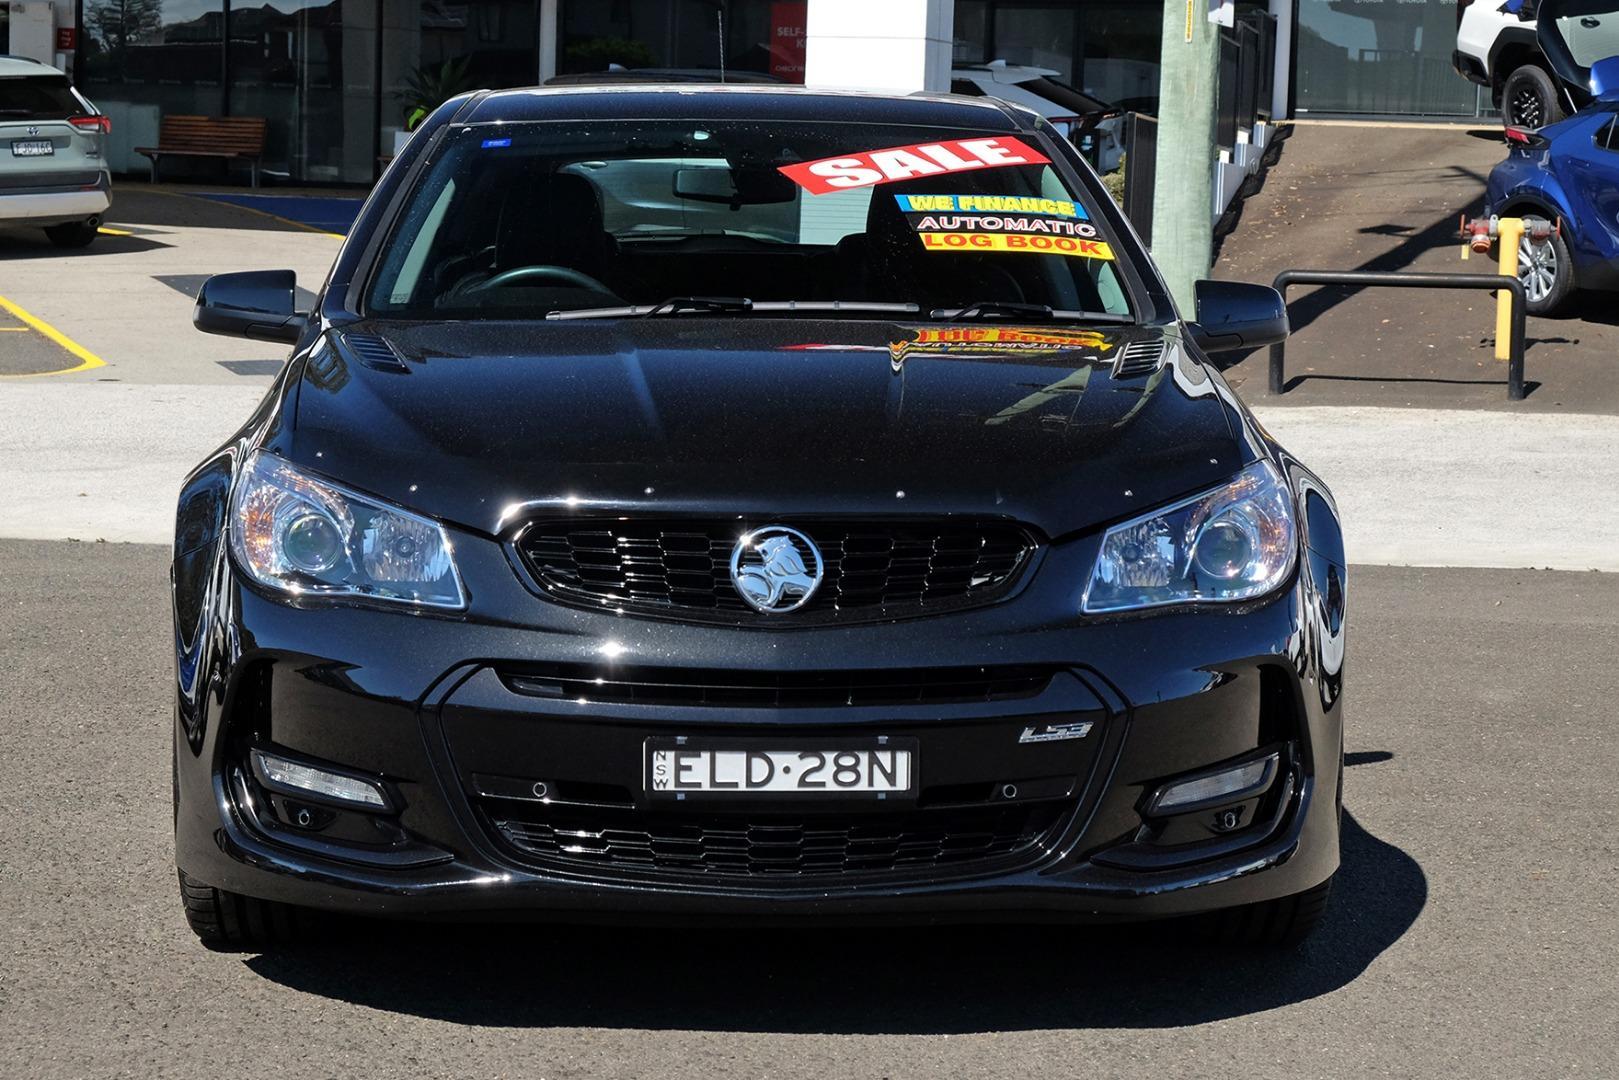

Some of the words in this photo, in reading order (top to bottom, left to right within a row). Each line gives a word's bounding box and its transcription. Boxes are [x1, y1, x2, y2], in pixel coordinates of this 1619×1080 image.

[808, 139, 1027, 188] SALE
[907, 195, 954, 211] WE
[959, 196, 1077, 216] FINANCE
[917, 216, 1097, 237] AUTOMATIC
[924, 234, 993, 249] LOG
[1006, 236, 1102, 255] BOOK
